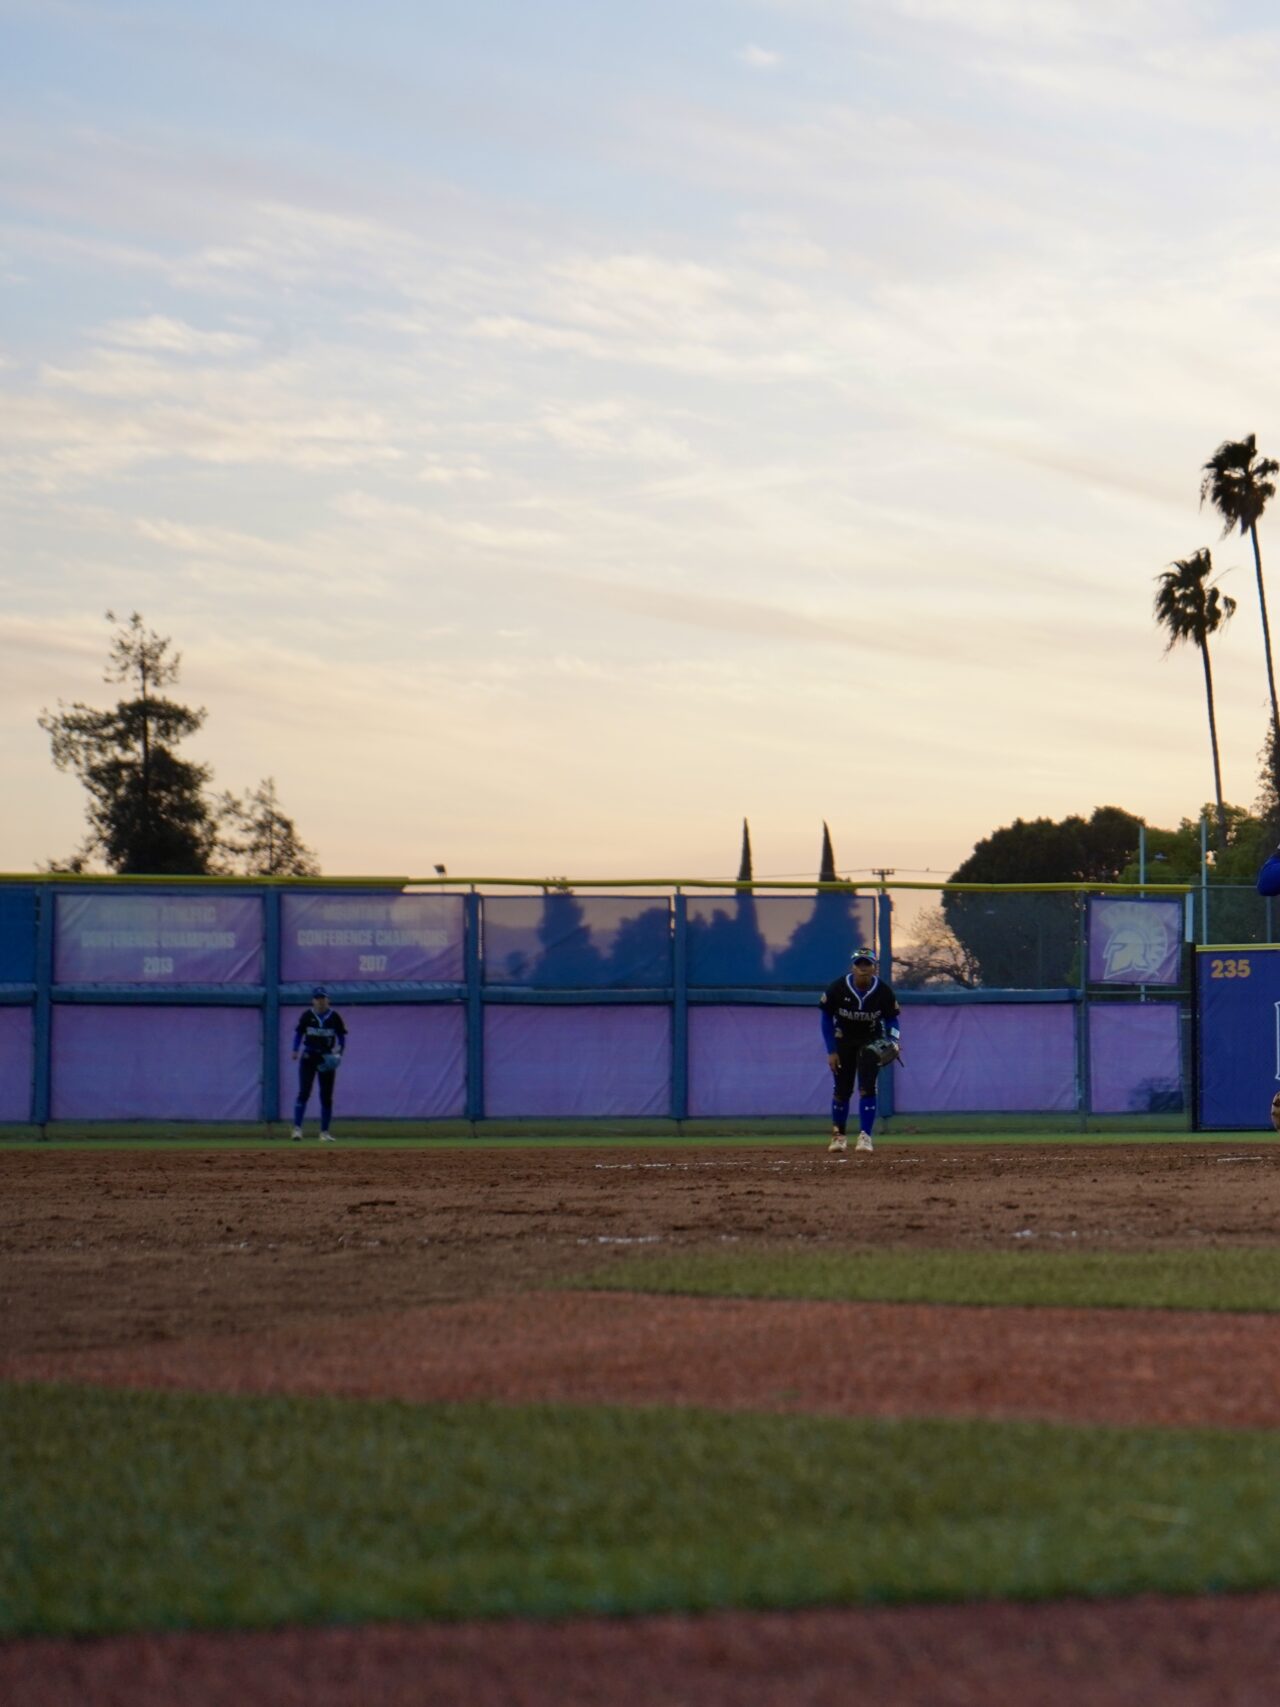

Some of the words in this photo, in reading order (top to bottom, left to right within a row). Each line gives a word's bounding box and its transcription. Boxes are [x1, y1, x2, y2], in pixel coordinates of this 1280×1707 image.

[297, 929, 373, 946] CONFERENCE
[375, 929, 448, 946] CHAMPIONS
[358, 955, 388, 972] 2017
[1211, 959, 1251, 978] 235
